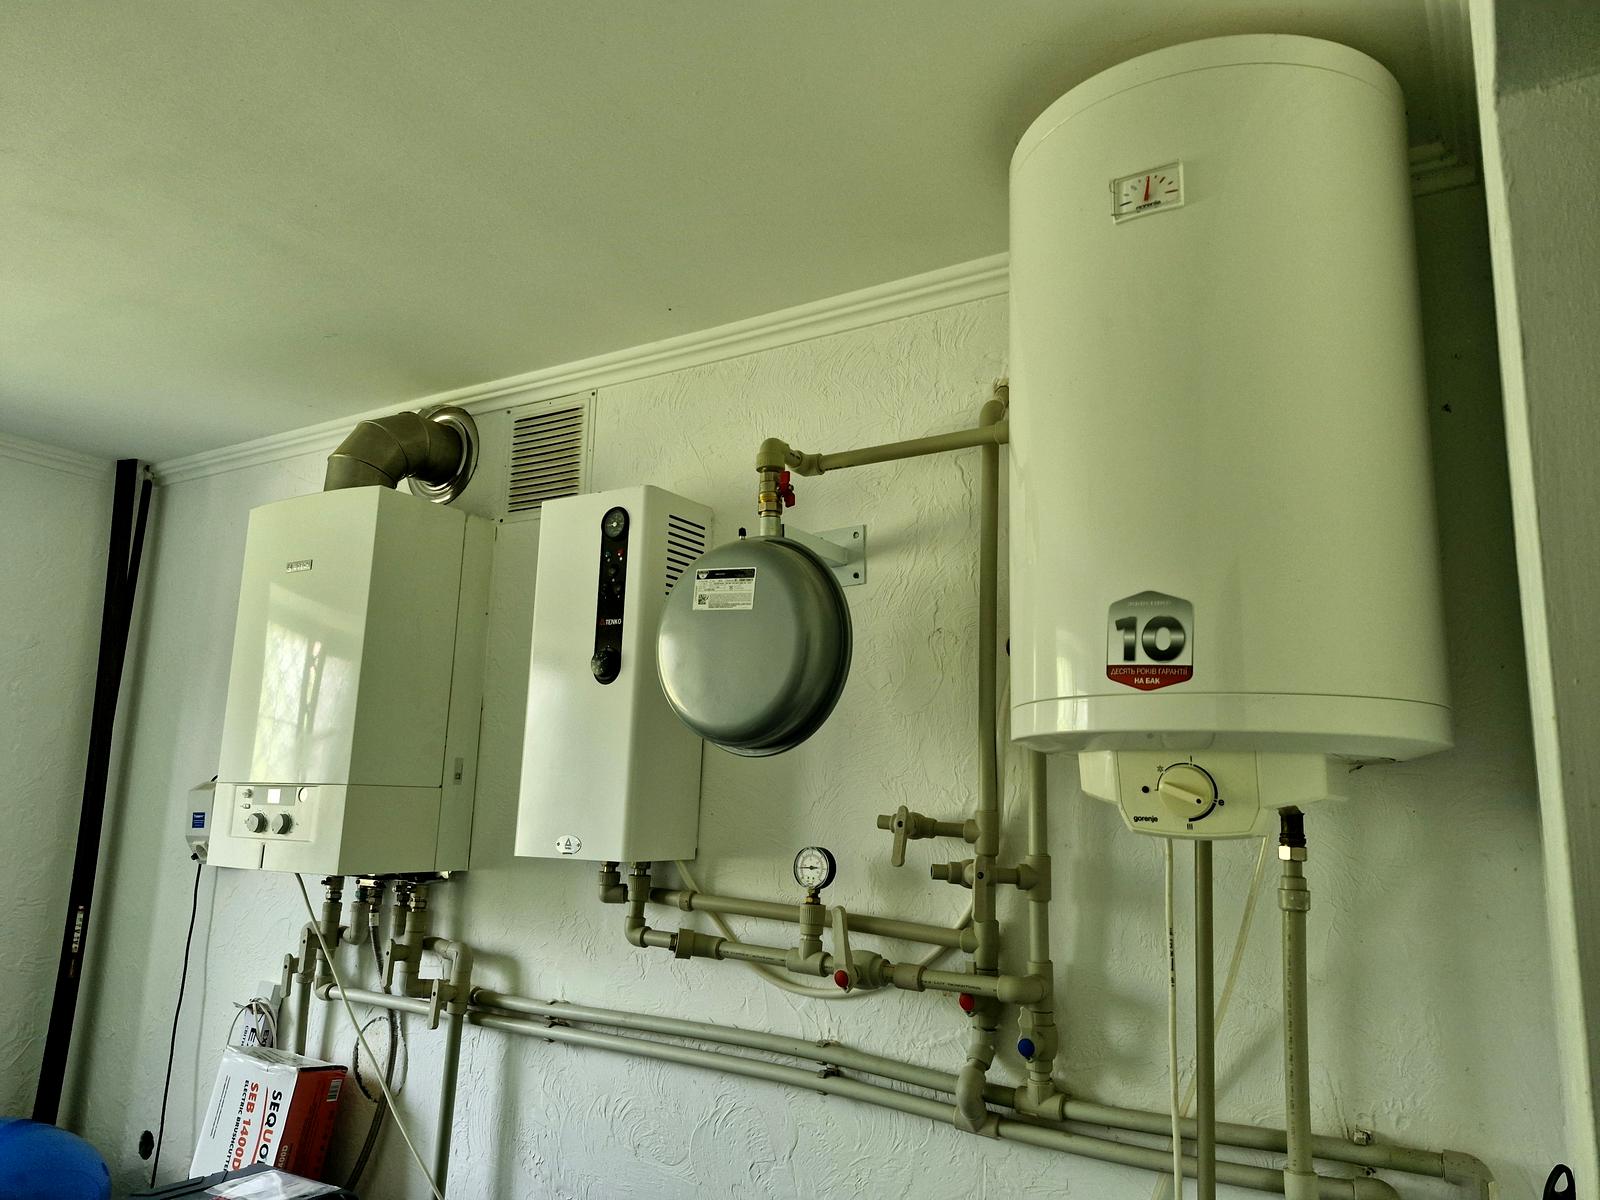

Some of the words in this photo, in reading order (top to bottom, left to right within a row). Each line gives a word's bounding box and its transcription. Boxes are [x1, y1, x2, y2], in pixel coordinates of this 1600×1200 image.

[605, 618, 622, 626] TENKO
[1115, 616, 1186, 663] 10
[1111, 667, 1136, 675] ДЕСЯТЬ
[1136, 667, 1157, 675] РОКІВ
[1133, 815, 1158, 823] gorenje
[237, 1080, 249, 1115] ELECTRIC
[246, 1082, 259, 1113] SEB
[232, 1118, 251, 1171] 1400D
